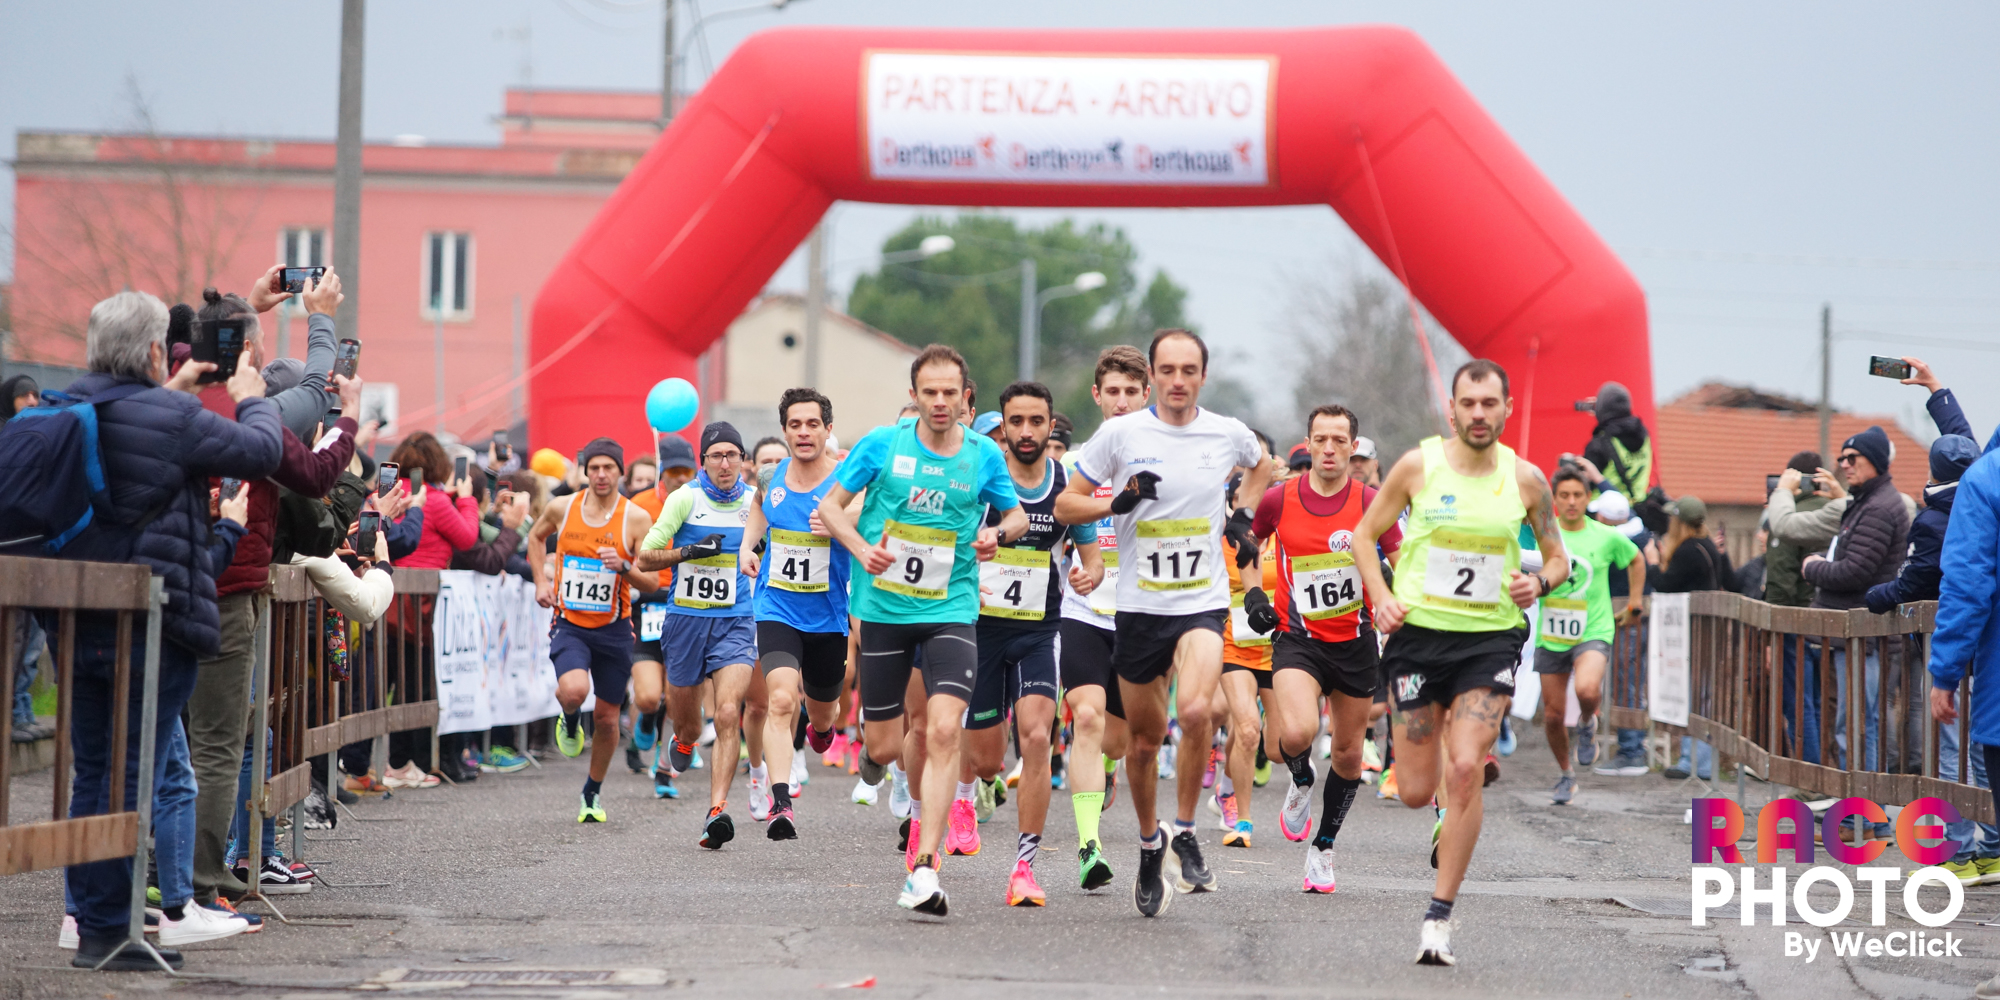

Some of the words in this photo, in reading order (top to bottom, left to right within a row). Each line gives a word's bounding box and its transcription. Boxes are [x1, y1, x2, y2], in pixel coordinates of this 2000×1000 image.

[881, 74, 1077, 115] PARTENZA
[1109, 80, 1252, 118] ARRIVO
[1425, 507, 1458, 515] DINAMO
[782, 558, 810, 581] 41
[904, 557, 924, 585] 9
[1147, 550, 1203, 579] 117
[564, 580, 611, 602] 1143
[684, 575, 730, 601] 199
[1004, 580, 1022, 607] 4
[1304, 578, 1356, 609] 164
[1454, 567, 1476, 597] 2
[1549, 617, 1580, 636] 110
